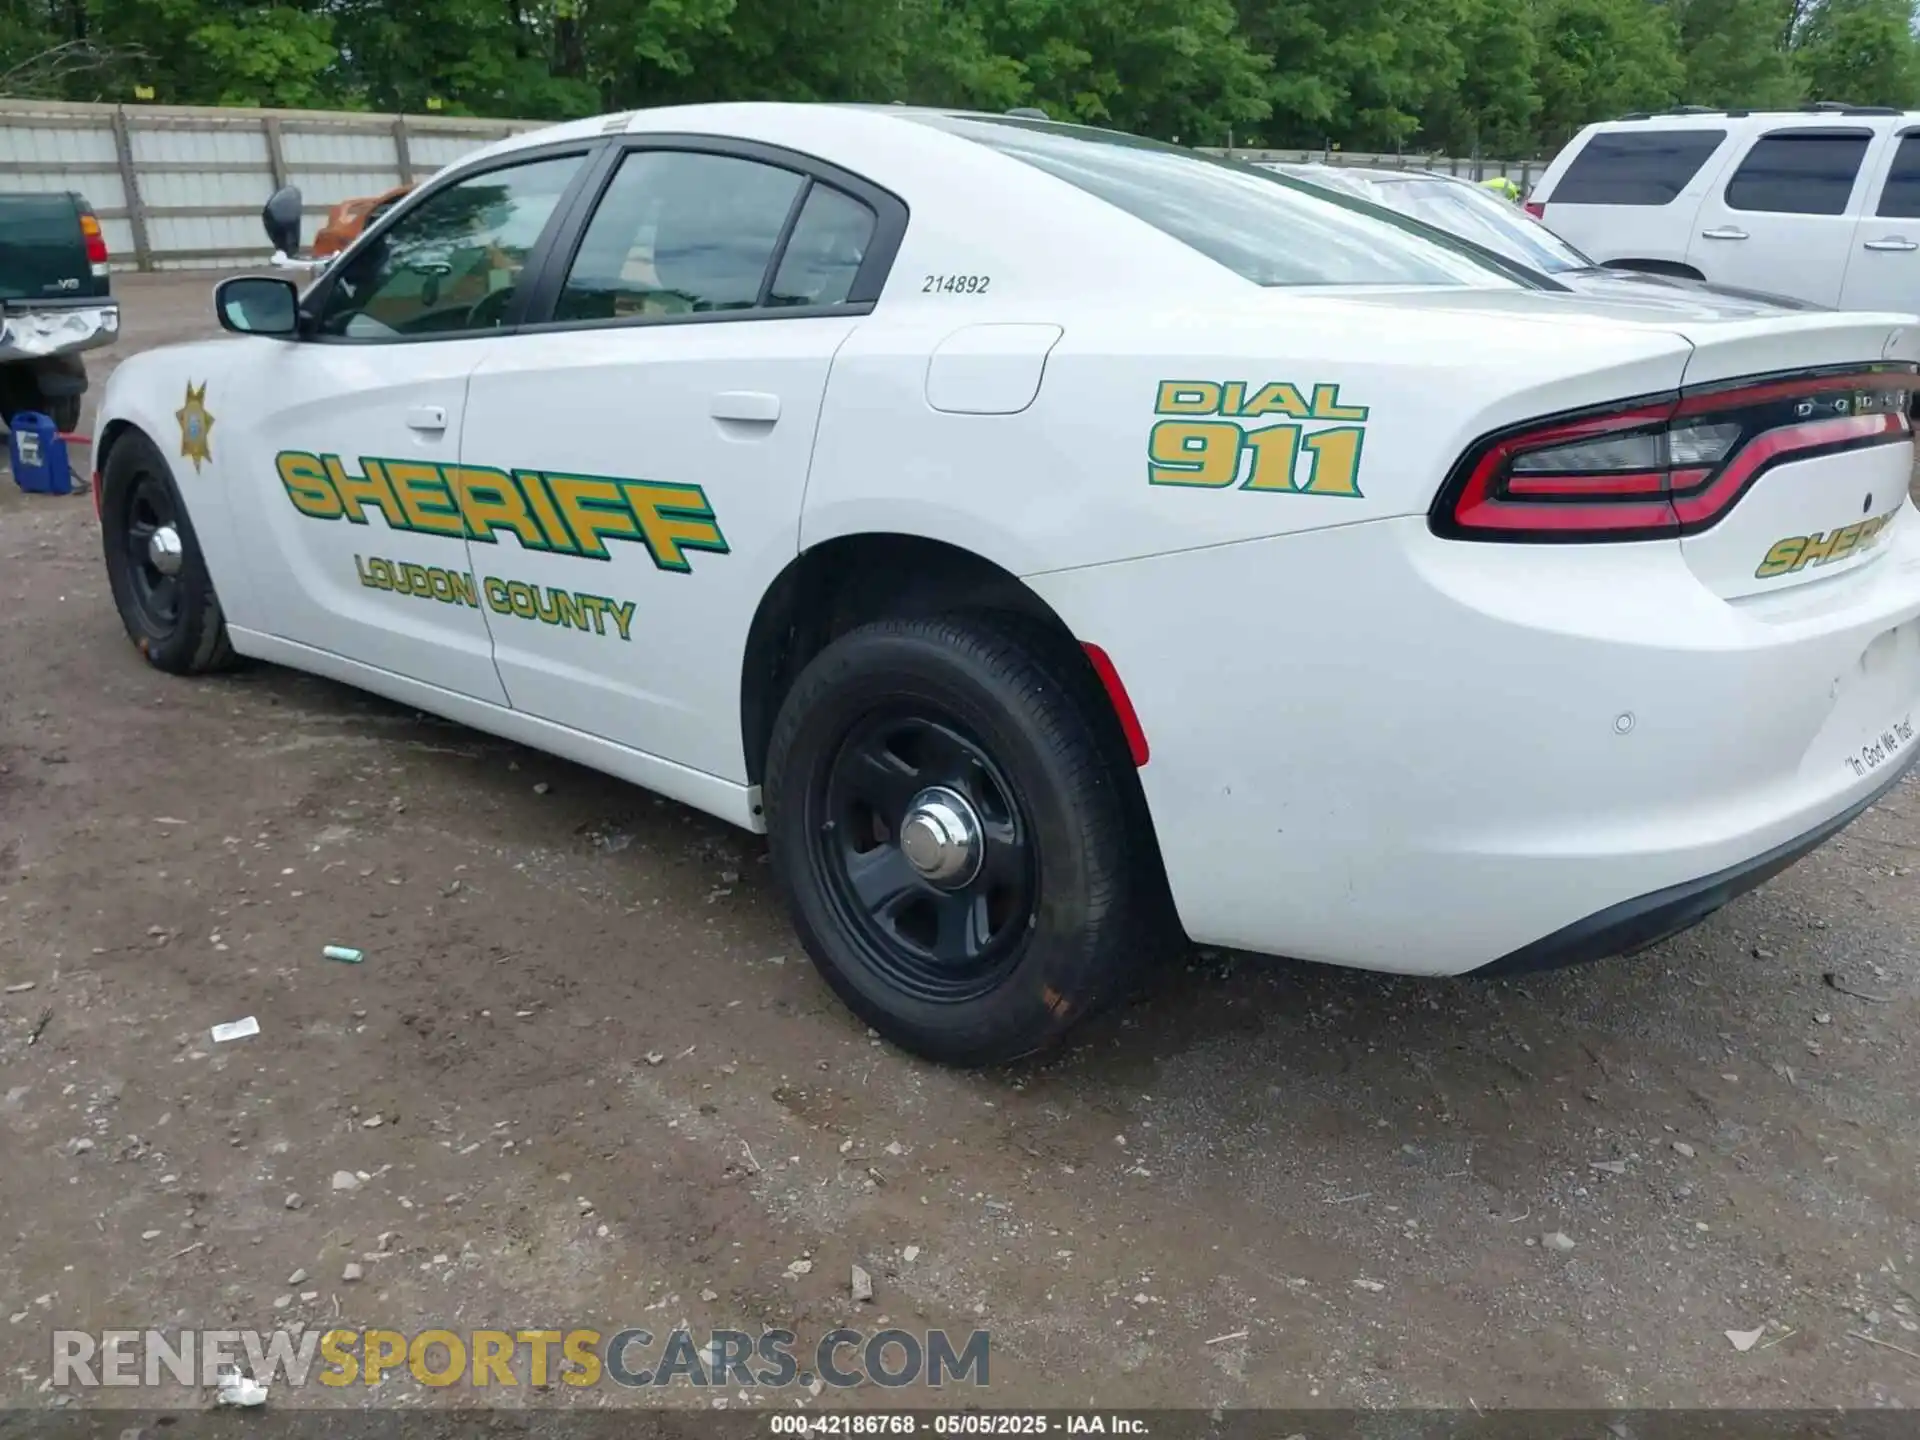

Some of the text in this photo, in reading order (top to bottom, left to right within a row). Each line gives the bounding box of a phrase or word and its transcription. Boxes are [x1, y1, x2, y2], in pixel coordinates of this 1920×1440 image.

[921, 275, 991, 294] 214892
[1154, 380, 1370, 421] DIAL
[1148, 420, 1365, 498] 911
[275, 450, 731, 574] SHERIFF
[354, 554, 636, 641] LOUDON COUNTY
[1862, 738, 1885, 768] God
[1880, 731, 1898, 753] We
